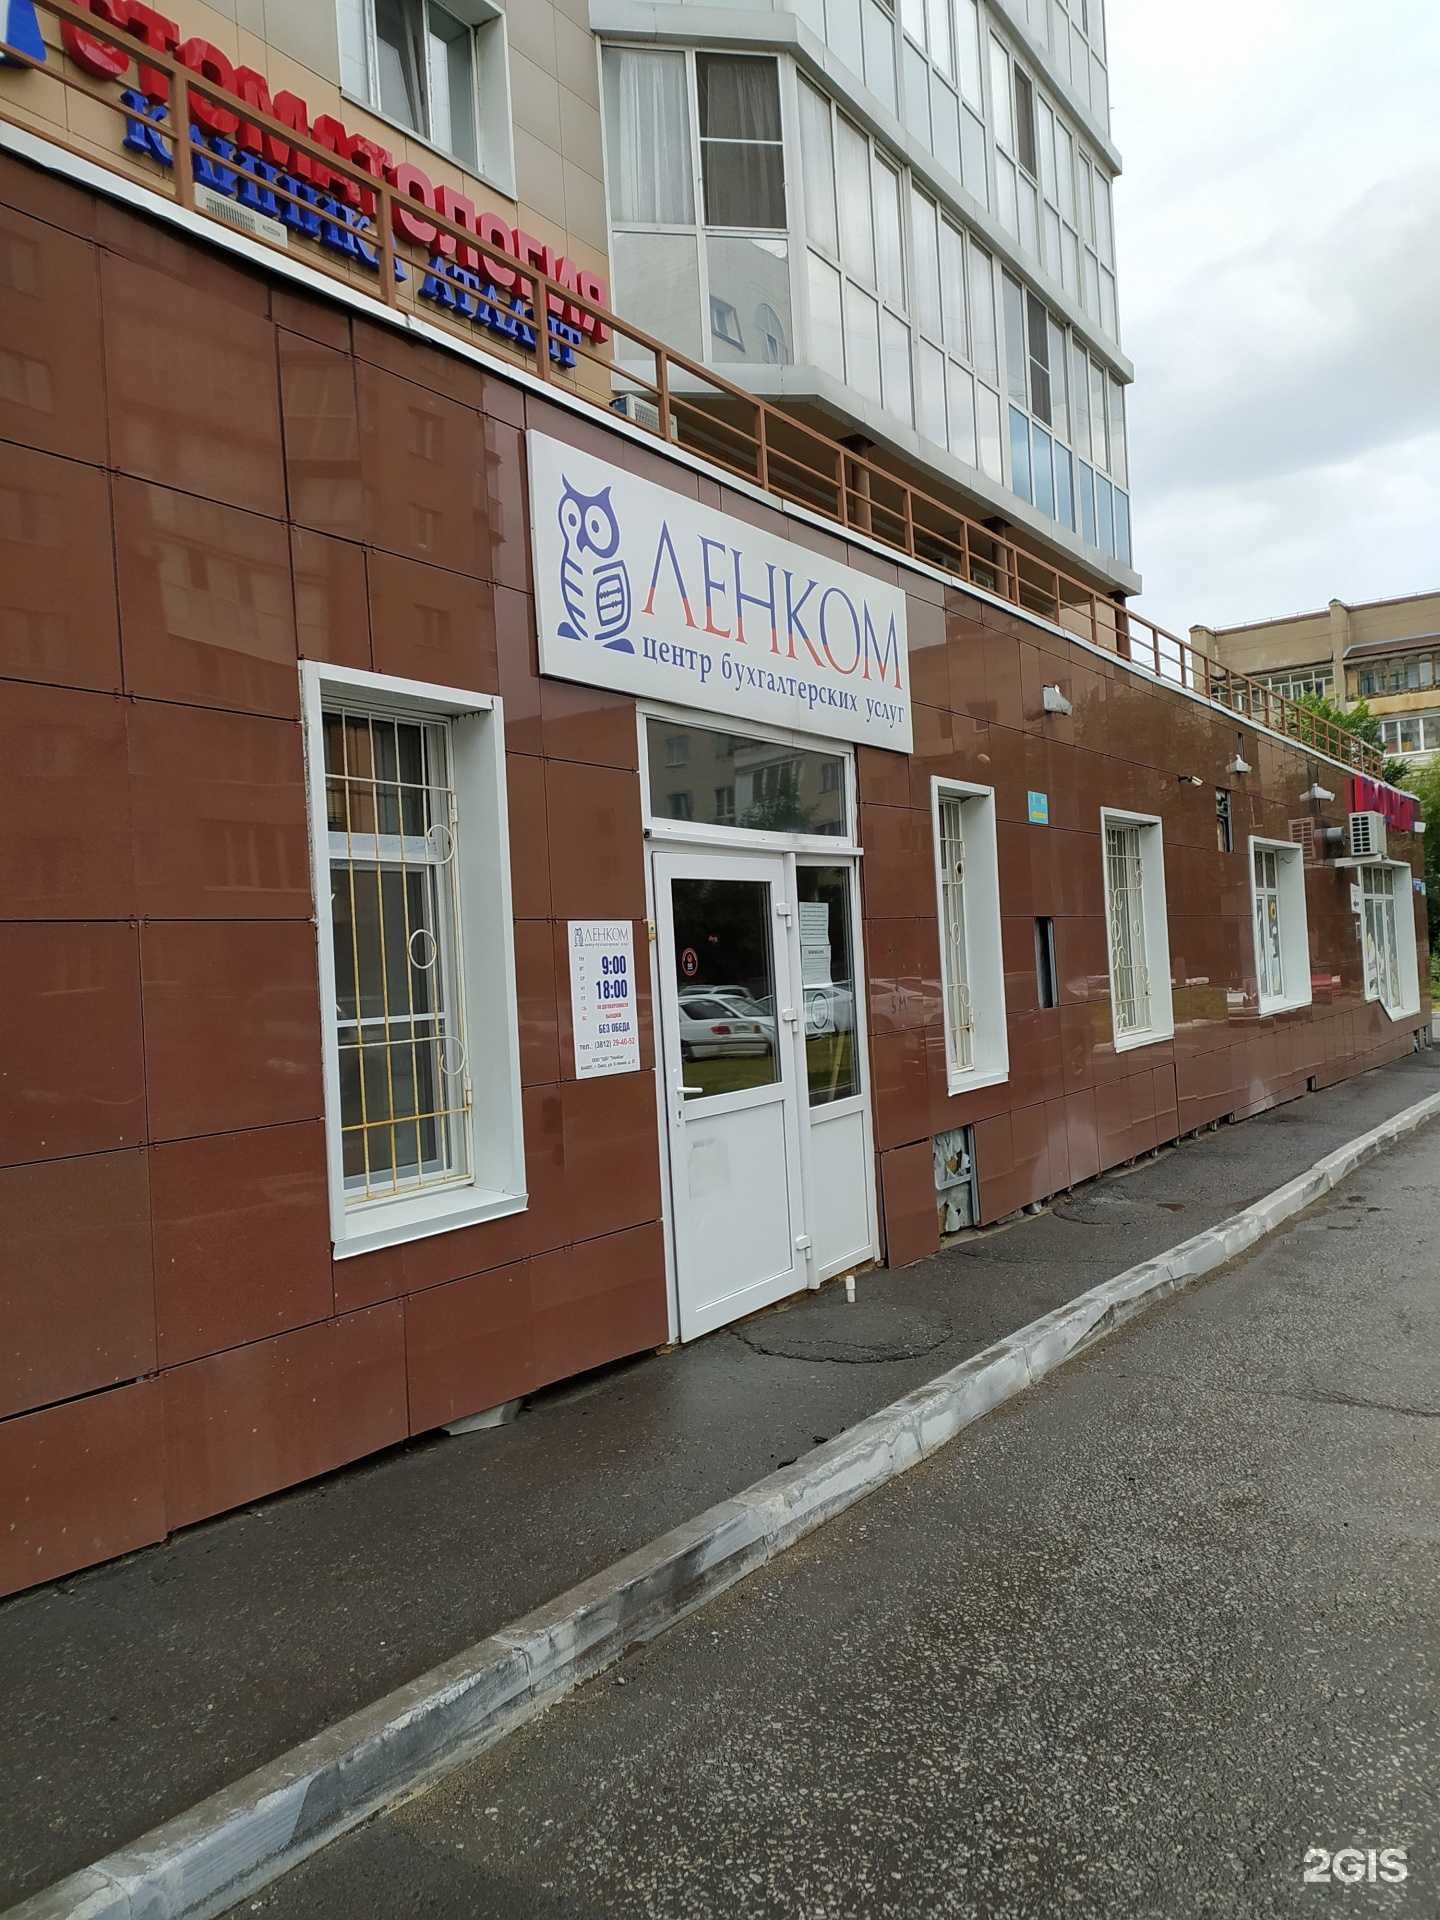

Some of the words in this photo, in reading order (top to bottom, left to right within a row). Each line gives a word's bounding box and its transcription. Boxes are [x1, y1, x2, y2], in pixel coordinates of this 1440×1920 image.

[60, 0, 611, 344] СТОМАТОЛОГИЯ
[641, 519, 903, 690] ЛЕНКОМ
[643, 635, 712, 684] центр
[721, 652, 858, 712] бухгалтерских
[865, 697, 905, 729] услуг
[585, 928, 629, 942] ЛЕНКОМ
[602, 956, 626, 975] 9:00
[596, 980, 627, 999] 18:00
[598, 1023, 611, 1034] БЕЗ
[611, 1022, 631, 1033] ОБЕДА
